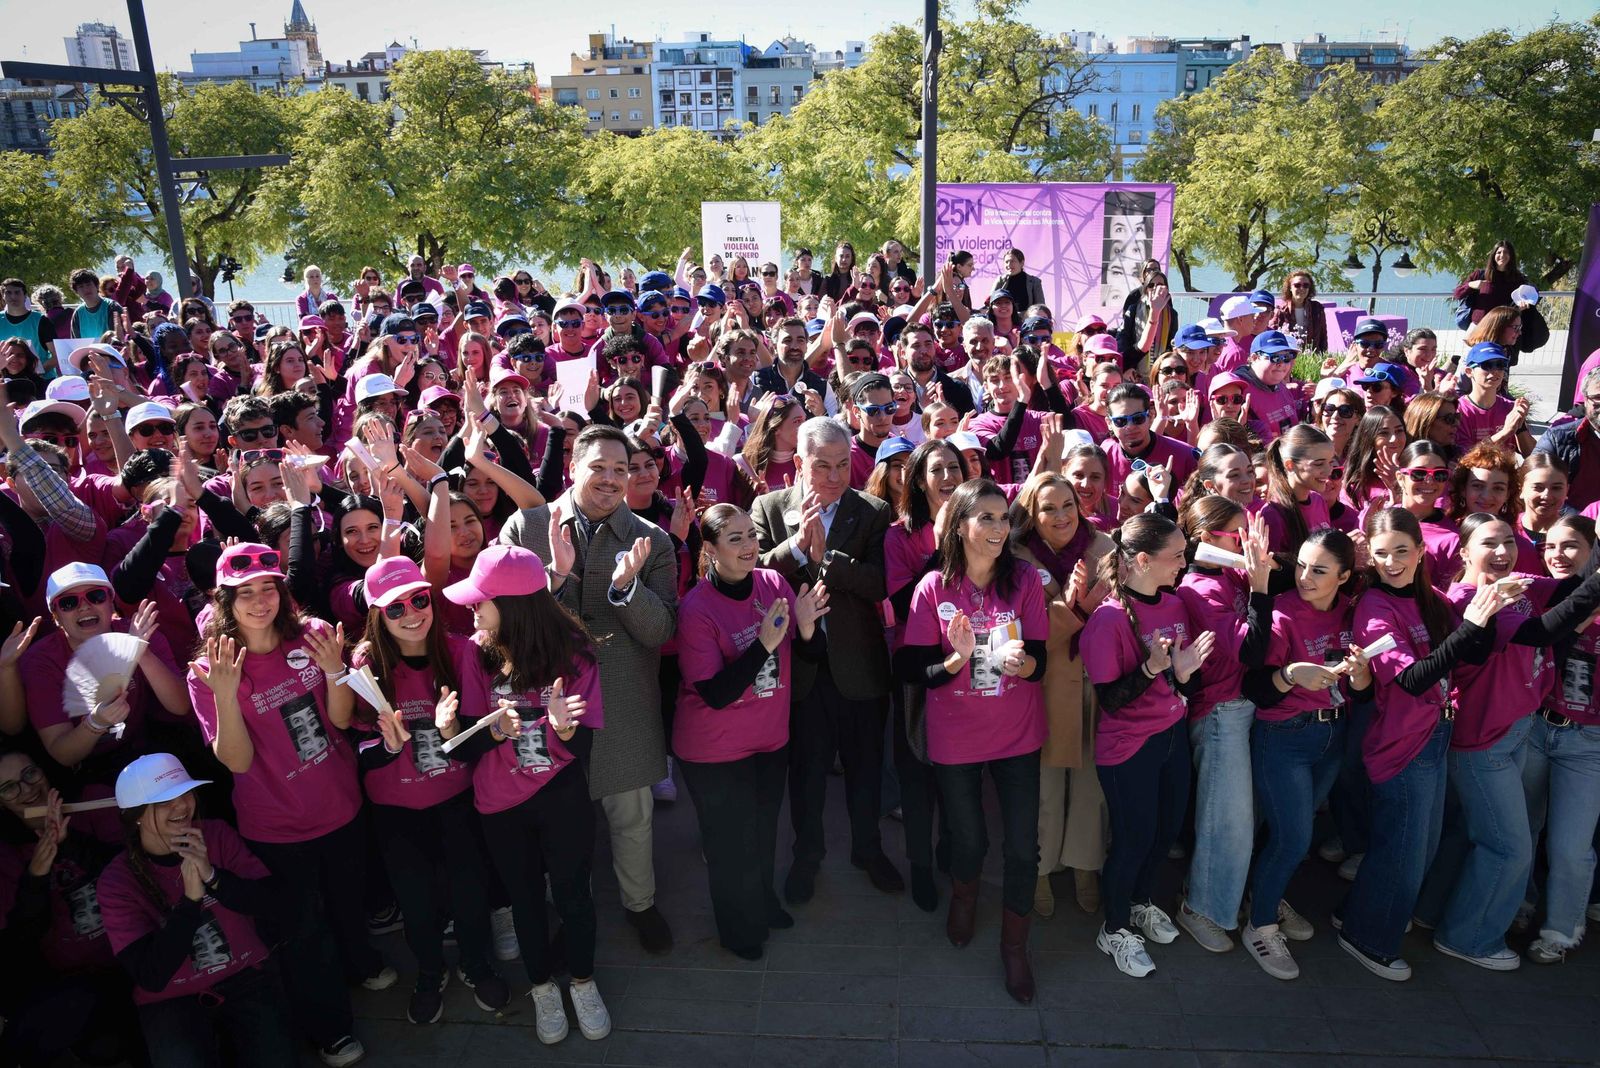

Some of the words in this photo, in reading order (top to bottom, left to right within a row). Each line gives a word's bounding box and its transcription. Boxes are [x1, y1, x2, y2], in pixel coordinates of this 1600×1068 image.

[734, 214, 756, 222] Clece
[936, 198, 982, 226] 25N
[1042, 218, 1065, 226] Mujeres
[936, 236, 954, 250] Sin
[996, 610, 1015, 622] 25N
[298, 664, 321, 682] 25N
[250, 692, 264, 702] Sin
[265, 678, 297, 696] violencia,
[254, 700, 266, 708] sin
